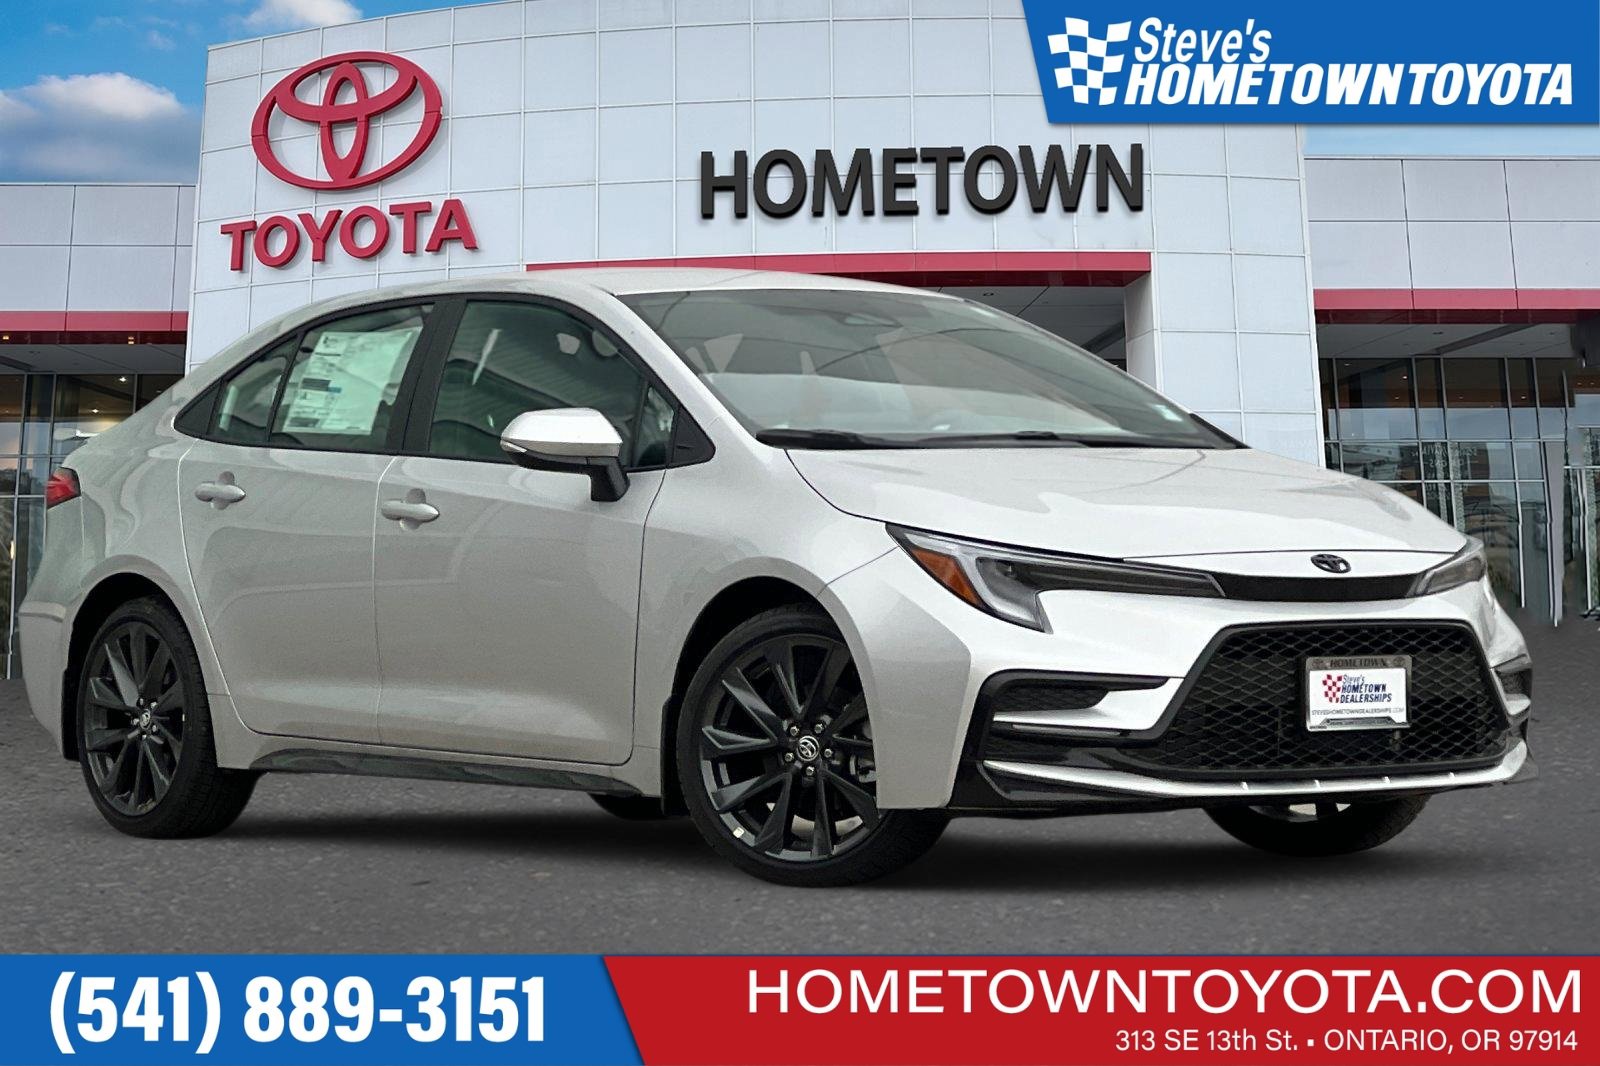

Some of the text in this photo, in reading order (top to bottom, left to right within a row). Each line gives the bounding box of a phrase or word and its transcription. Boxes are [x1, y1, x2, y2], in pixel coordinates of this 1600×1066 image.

[700, 144, 1144, 219] HOMETOWN
[221, 199, 478, 271] TOYOTA
[1343, 674, 1365, 683] Steve's
[1341, 683, 1387, 694] HOMETOWN
[1340, 693, 1392, 704] DEALERSHIPS
